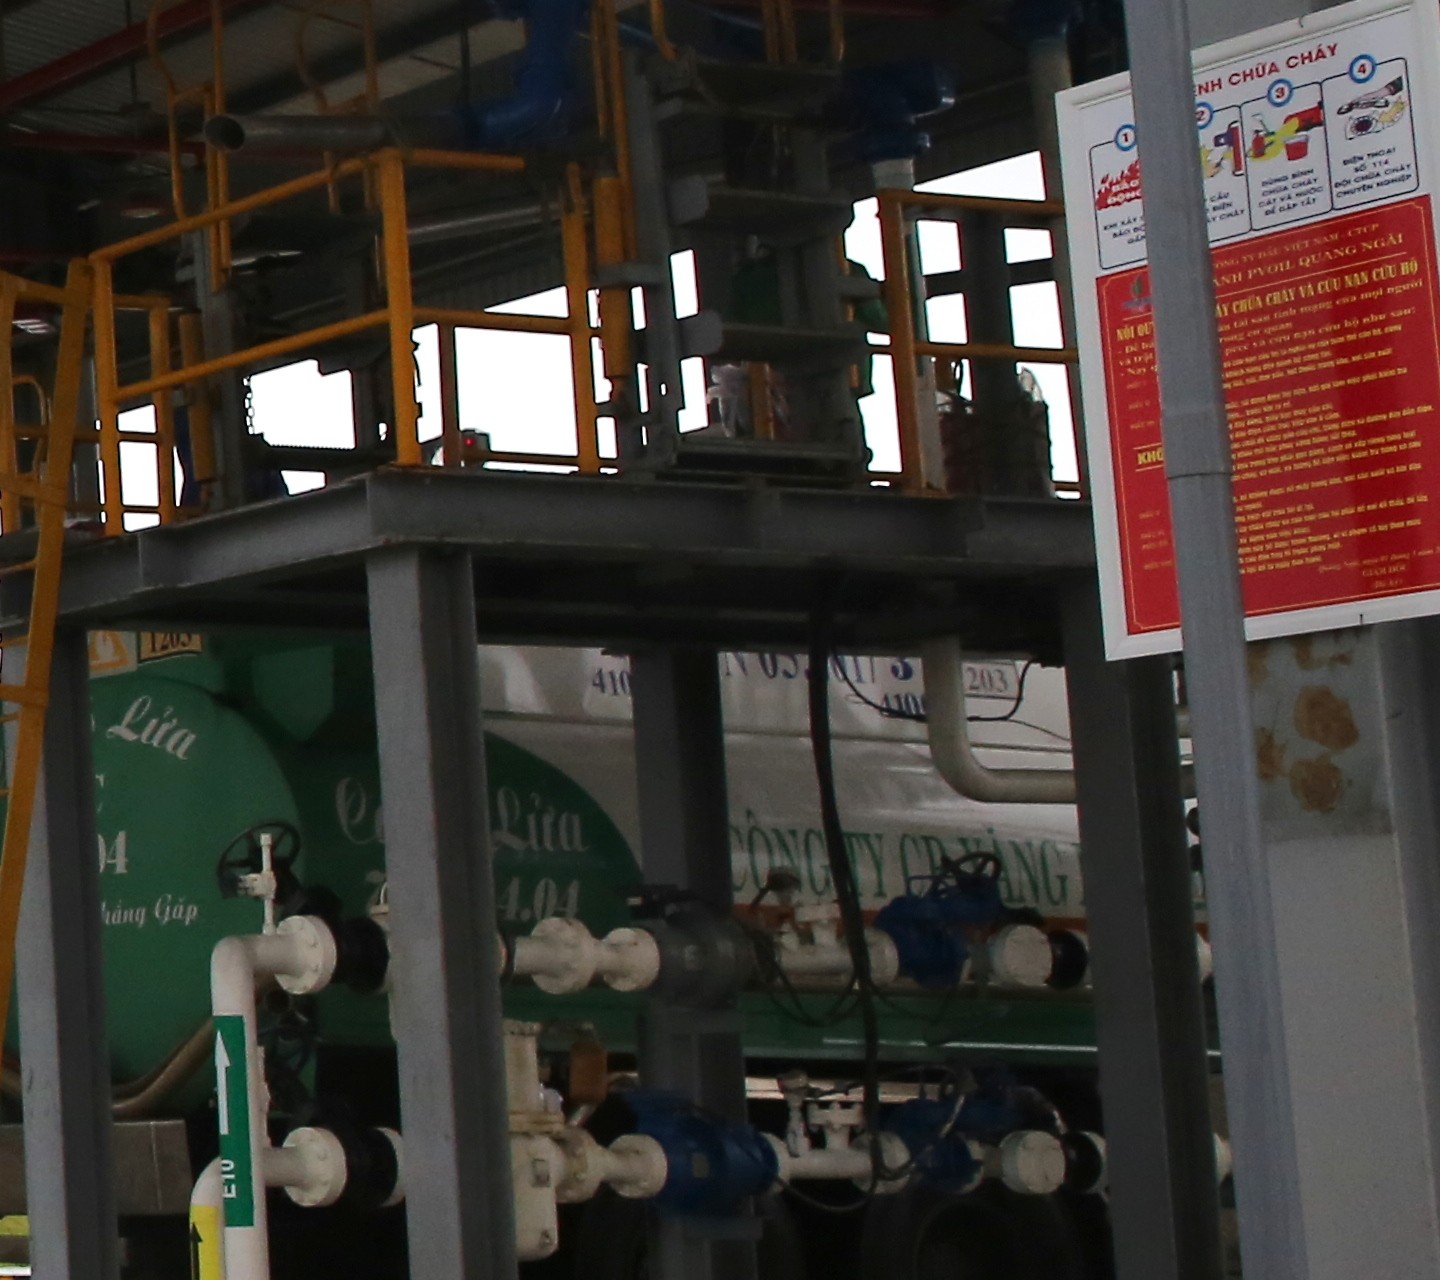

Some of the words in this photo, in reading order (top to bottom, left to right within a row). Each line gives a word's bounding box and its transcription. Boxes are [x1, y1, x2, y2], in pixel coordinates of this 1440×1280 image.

[1228, 63, 1280, 86] CHỮA
[1286, 43, 1339, 70] CHÁY
[1356, 64, 1368, 75] 4
[1275, 86, 1286, 99] 3
[1121, 132, 1129, 143] 1
[1248, 259, 1293, 280] PVOIL
[729, 808, 832, 897] CÔNG
